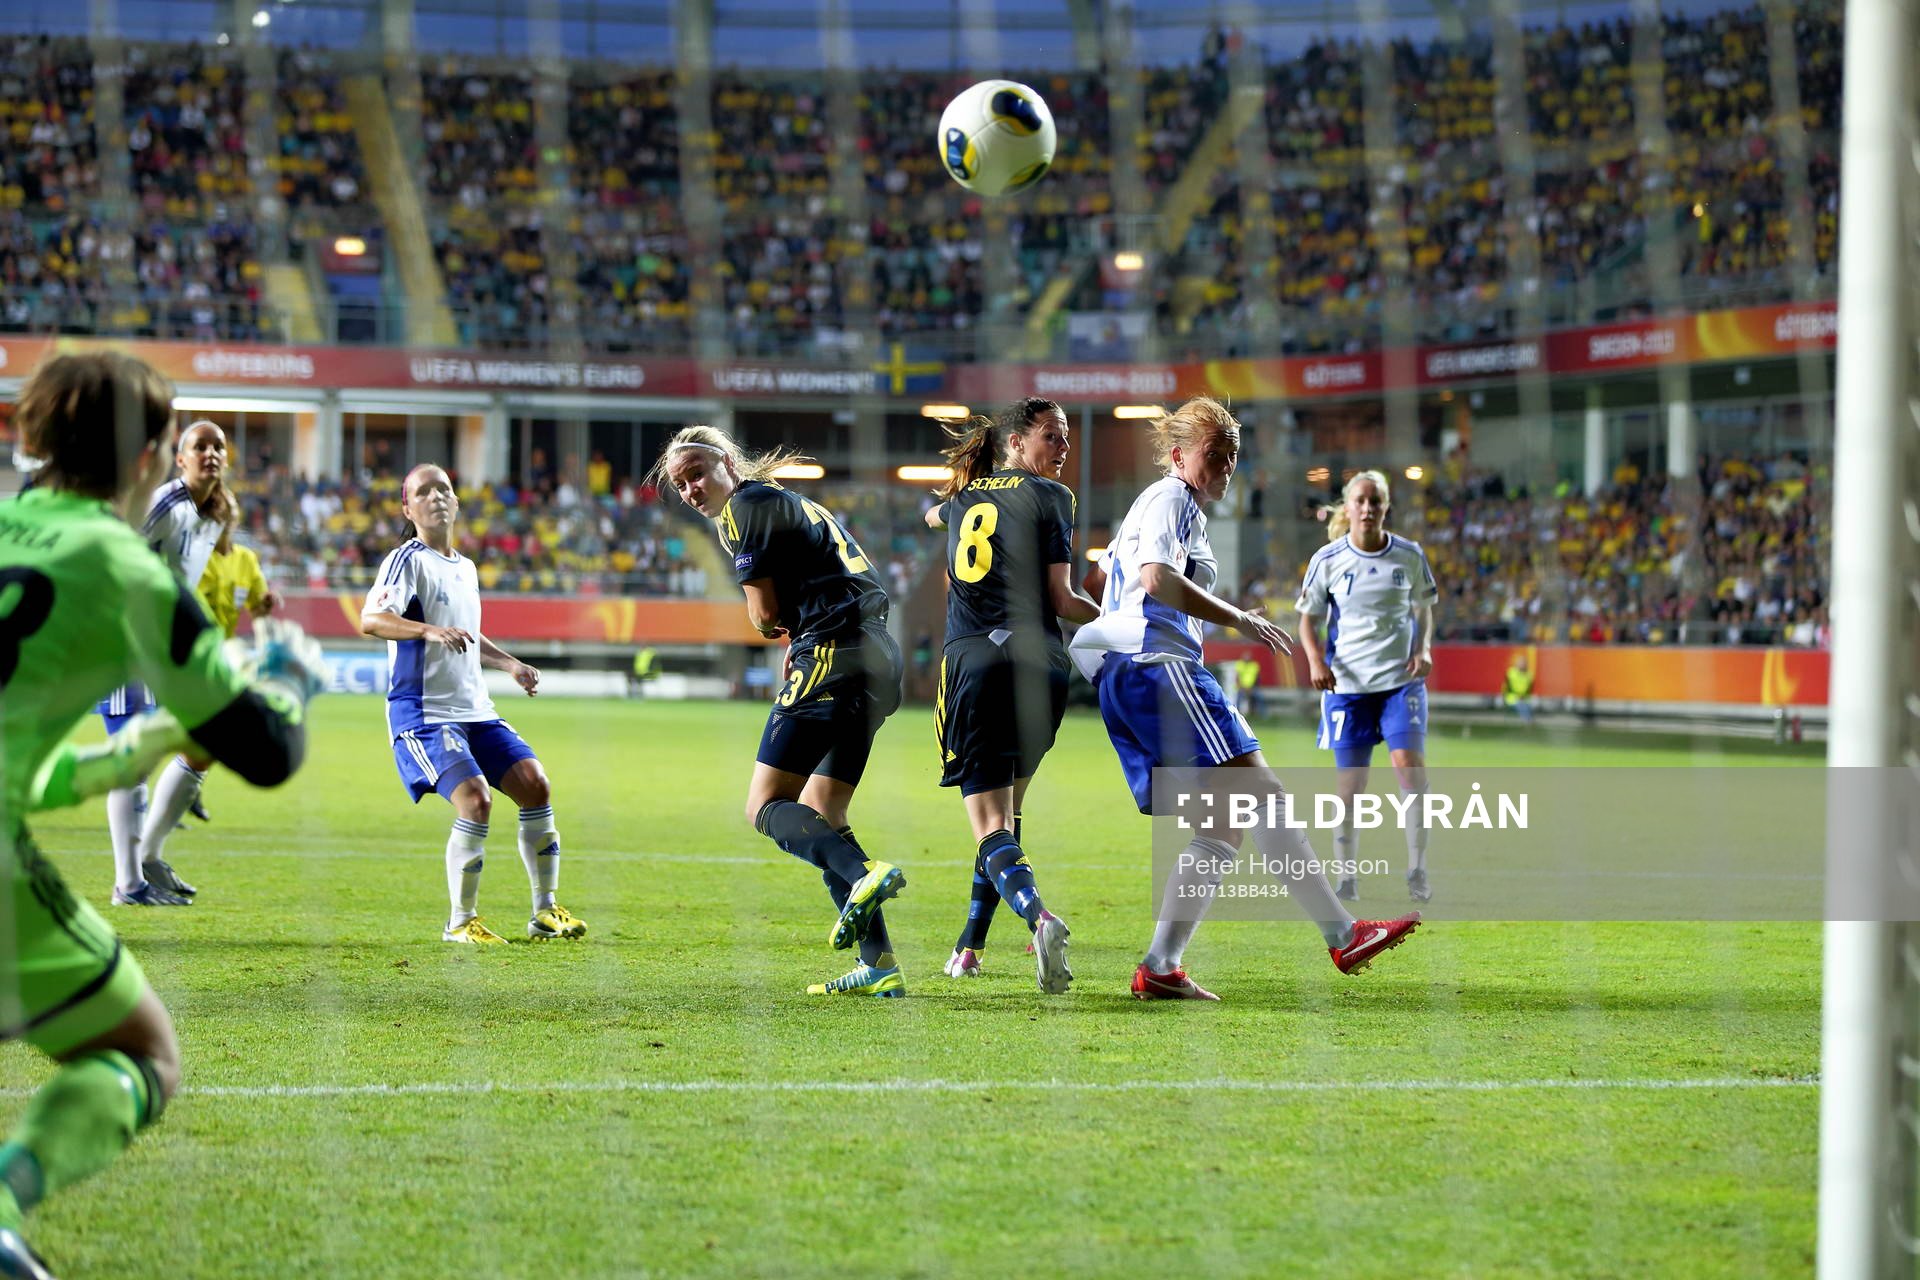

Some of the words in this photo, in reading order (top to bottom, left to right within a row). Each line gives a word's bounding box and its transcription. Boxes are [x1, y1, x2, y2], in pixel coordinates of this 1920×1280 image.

[410, 358, 476, 383] UEFA
[968, 476, 1025, 491] SCHELIN
[800, 498, 873, 574] 2
[955, 502, 998, 583] 8
[1344, 572, 1354, 596] 7
[774, 669, 804, 707] 3
[1331, 711, 1346, 741] 7
